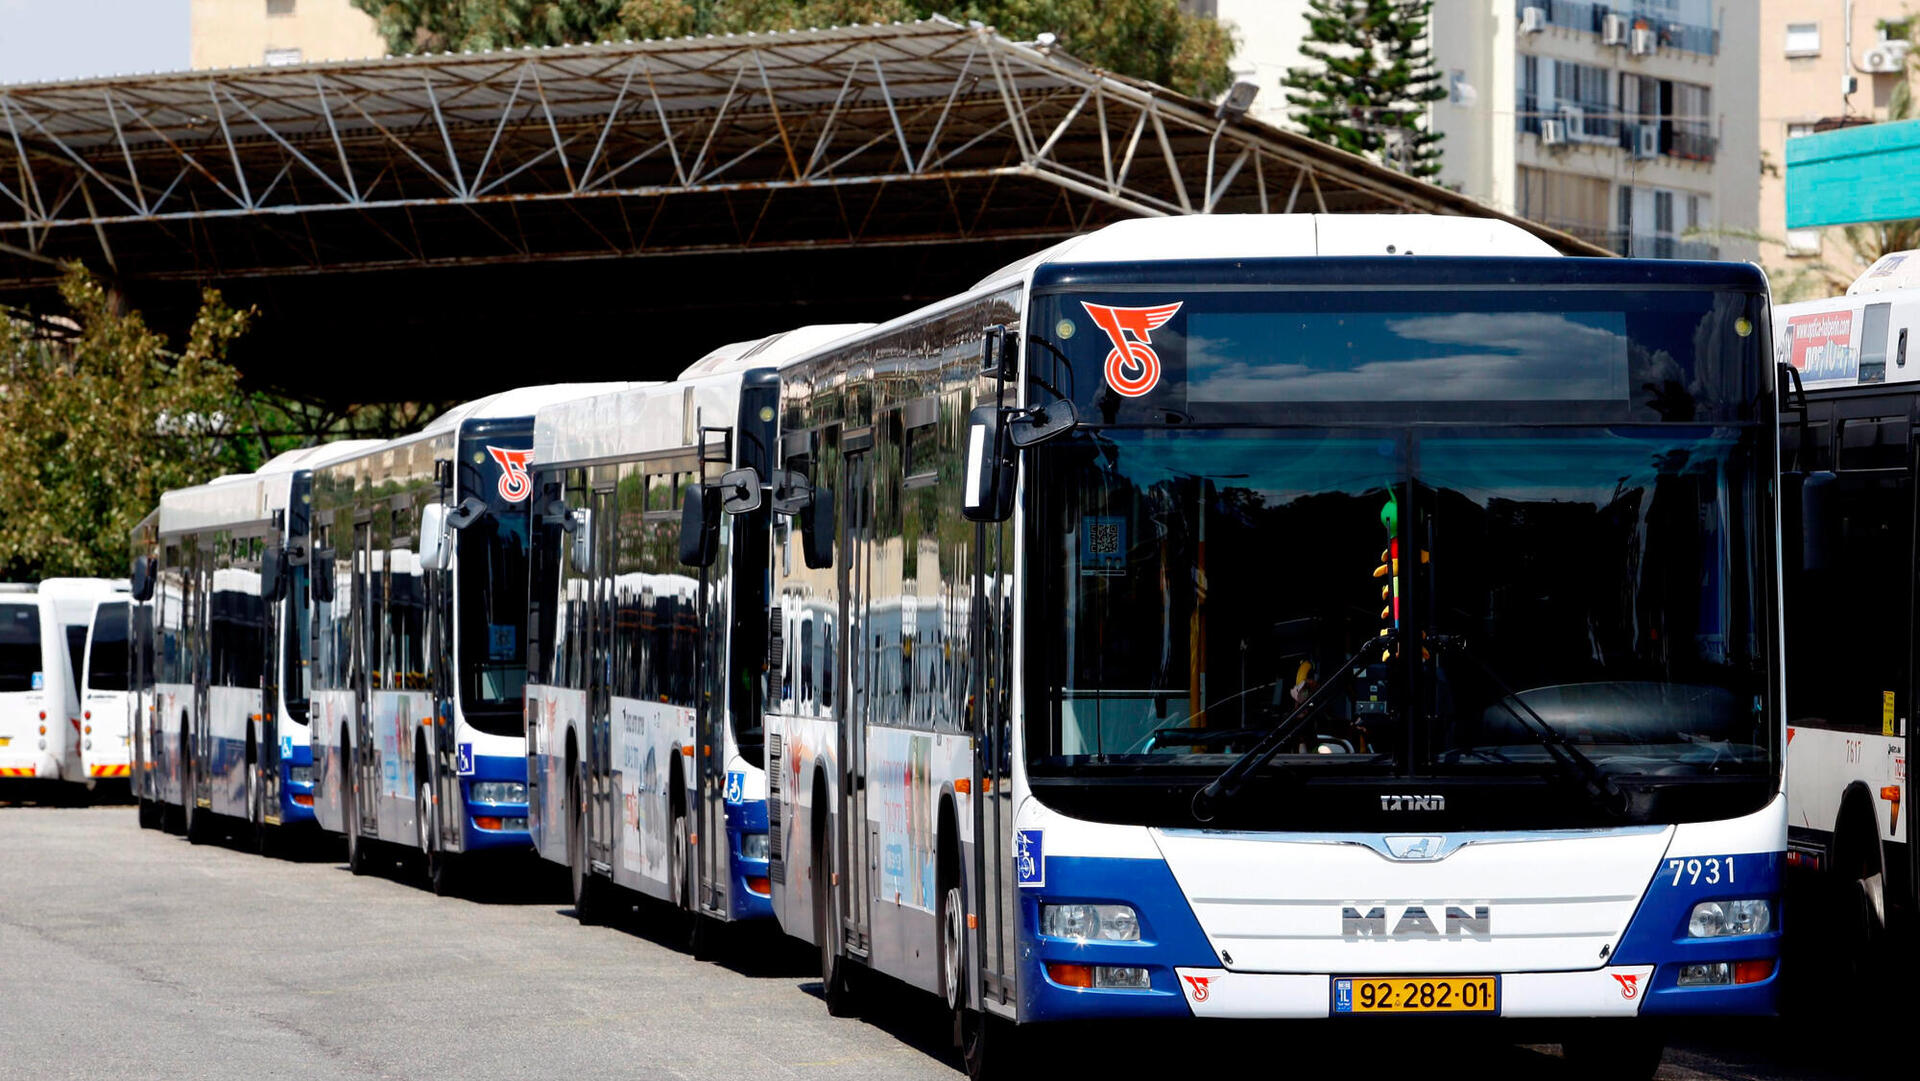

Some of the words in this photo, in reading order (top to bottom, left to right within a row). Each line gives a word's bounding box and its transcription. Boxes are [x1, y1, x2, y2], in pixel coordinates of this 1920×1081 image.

[1380, 794, 1445, 811] הארגז
[1669, 856, 1735, 887] 7931
[1341, 906, 1491, 938] MAN
